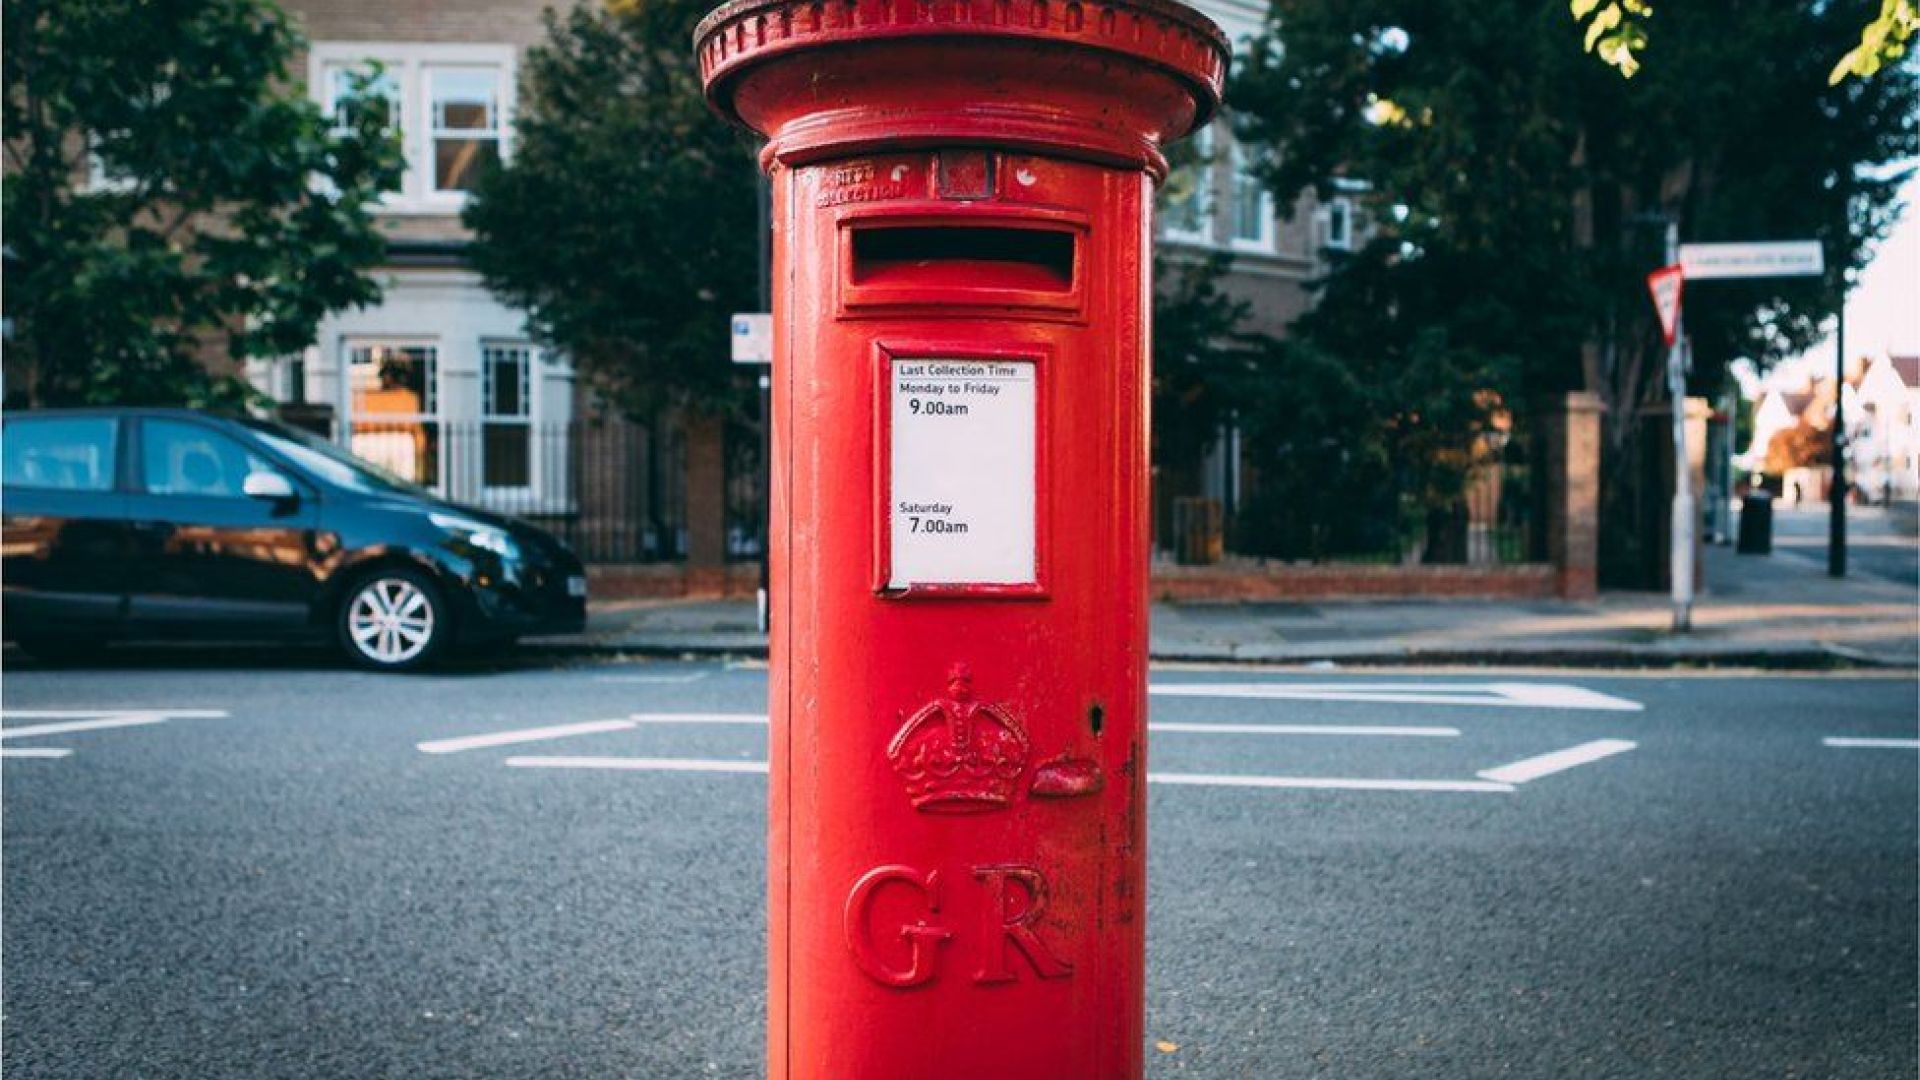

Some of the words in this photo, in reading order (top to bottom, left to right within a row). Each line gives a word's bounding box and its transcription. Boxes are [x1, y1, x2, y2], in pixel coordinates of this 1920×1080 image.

[899, 365, 924, 376] Last
[928, 364, 984, 376] Collection
[987, 365, 1017, 376] Time
[899, 383, 945, 396] Monday
[948, 384, 961, 395] to
[963, 383, 1000, 396] Friday
[909, 398, 968, 414] 9.00am
[899, 502, 952, 516] Saturday
[909, 517, 968, 533] 7.00am
